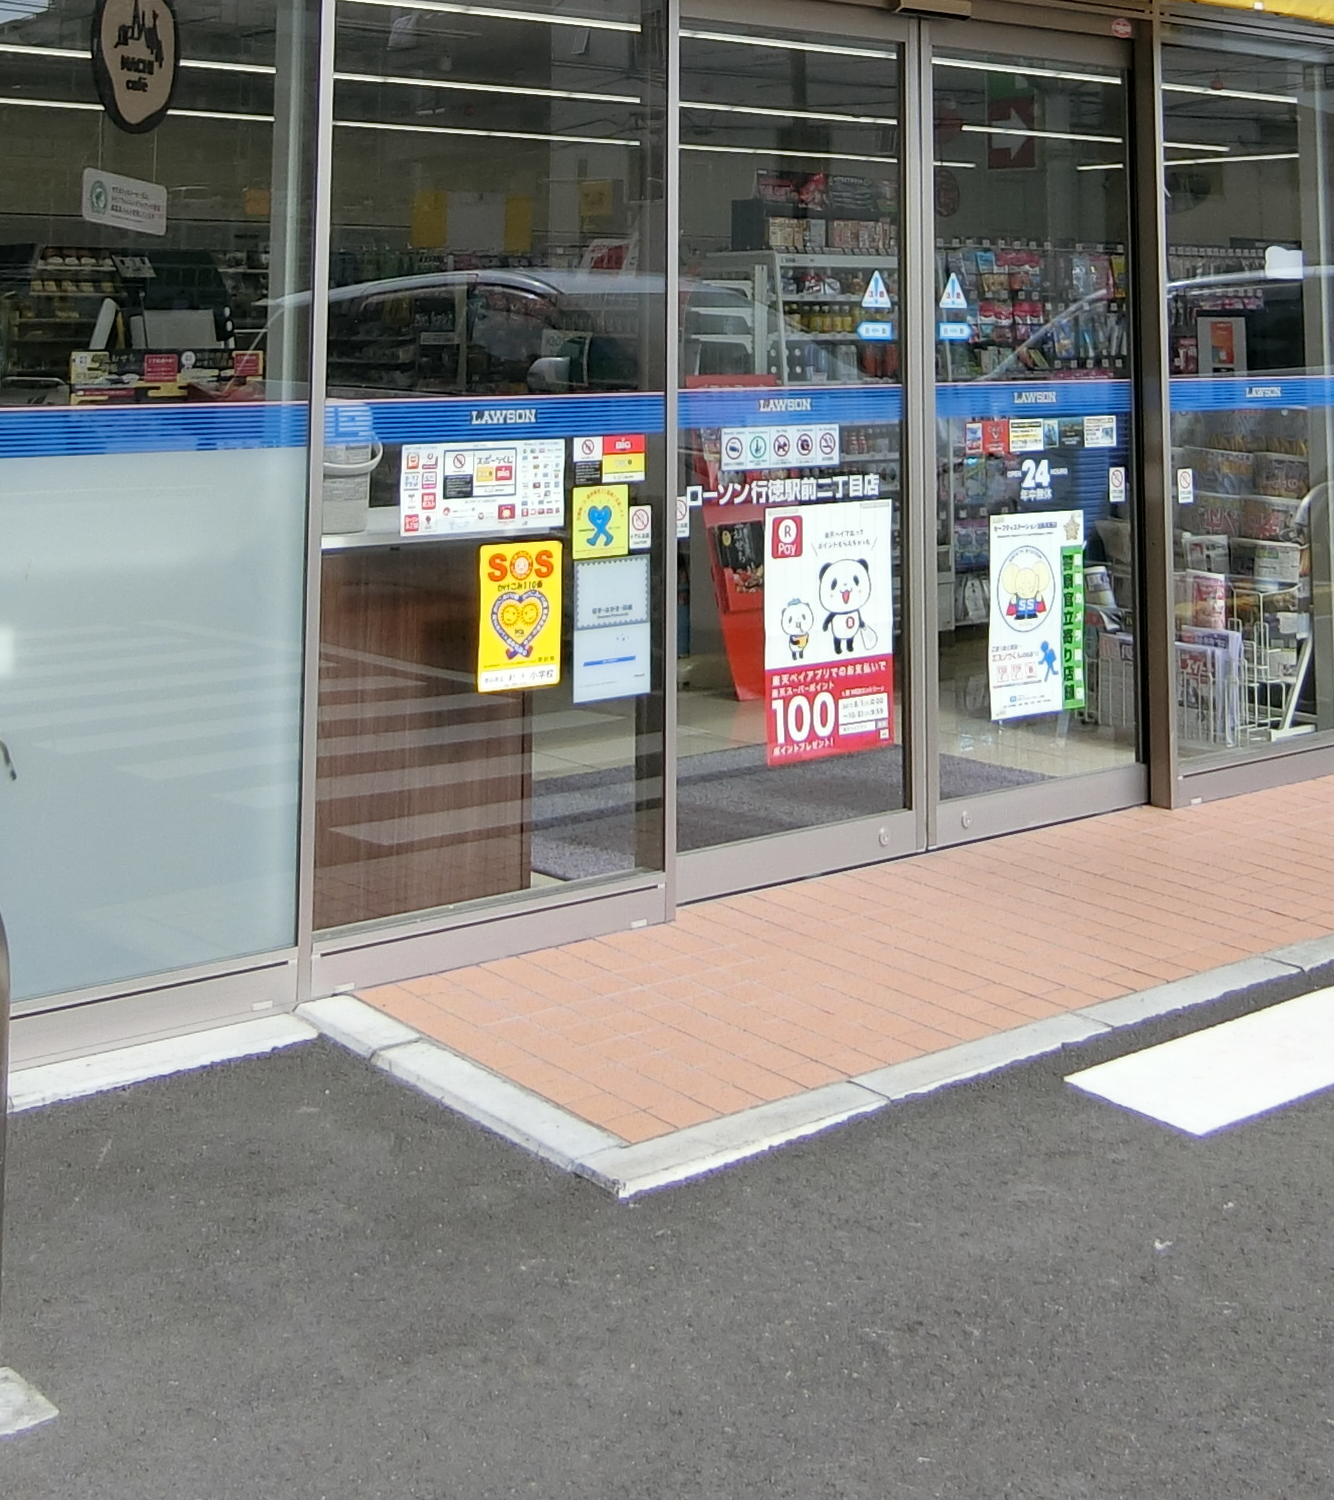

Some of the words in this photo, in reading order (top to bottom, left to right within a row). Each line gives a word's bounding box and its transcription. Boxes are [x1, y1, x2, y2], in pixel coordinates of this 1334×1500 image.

[1014, 391, 1057, 403] LAWSON
[1245, 386, 1282, 398] LAWSON
[759, 397, 812, 412] LAWSON
[471, 408, 537, 425] LAWSON
[1020, 458, 1050, 489] 24
[686, 473, 881, 507] ローソン行徳駅前二丁目店
[783, 524, 792, 539] R
[777, 543, 797, 556] Pay
[771, 691, 836, 744] 100
